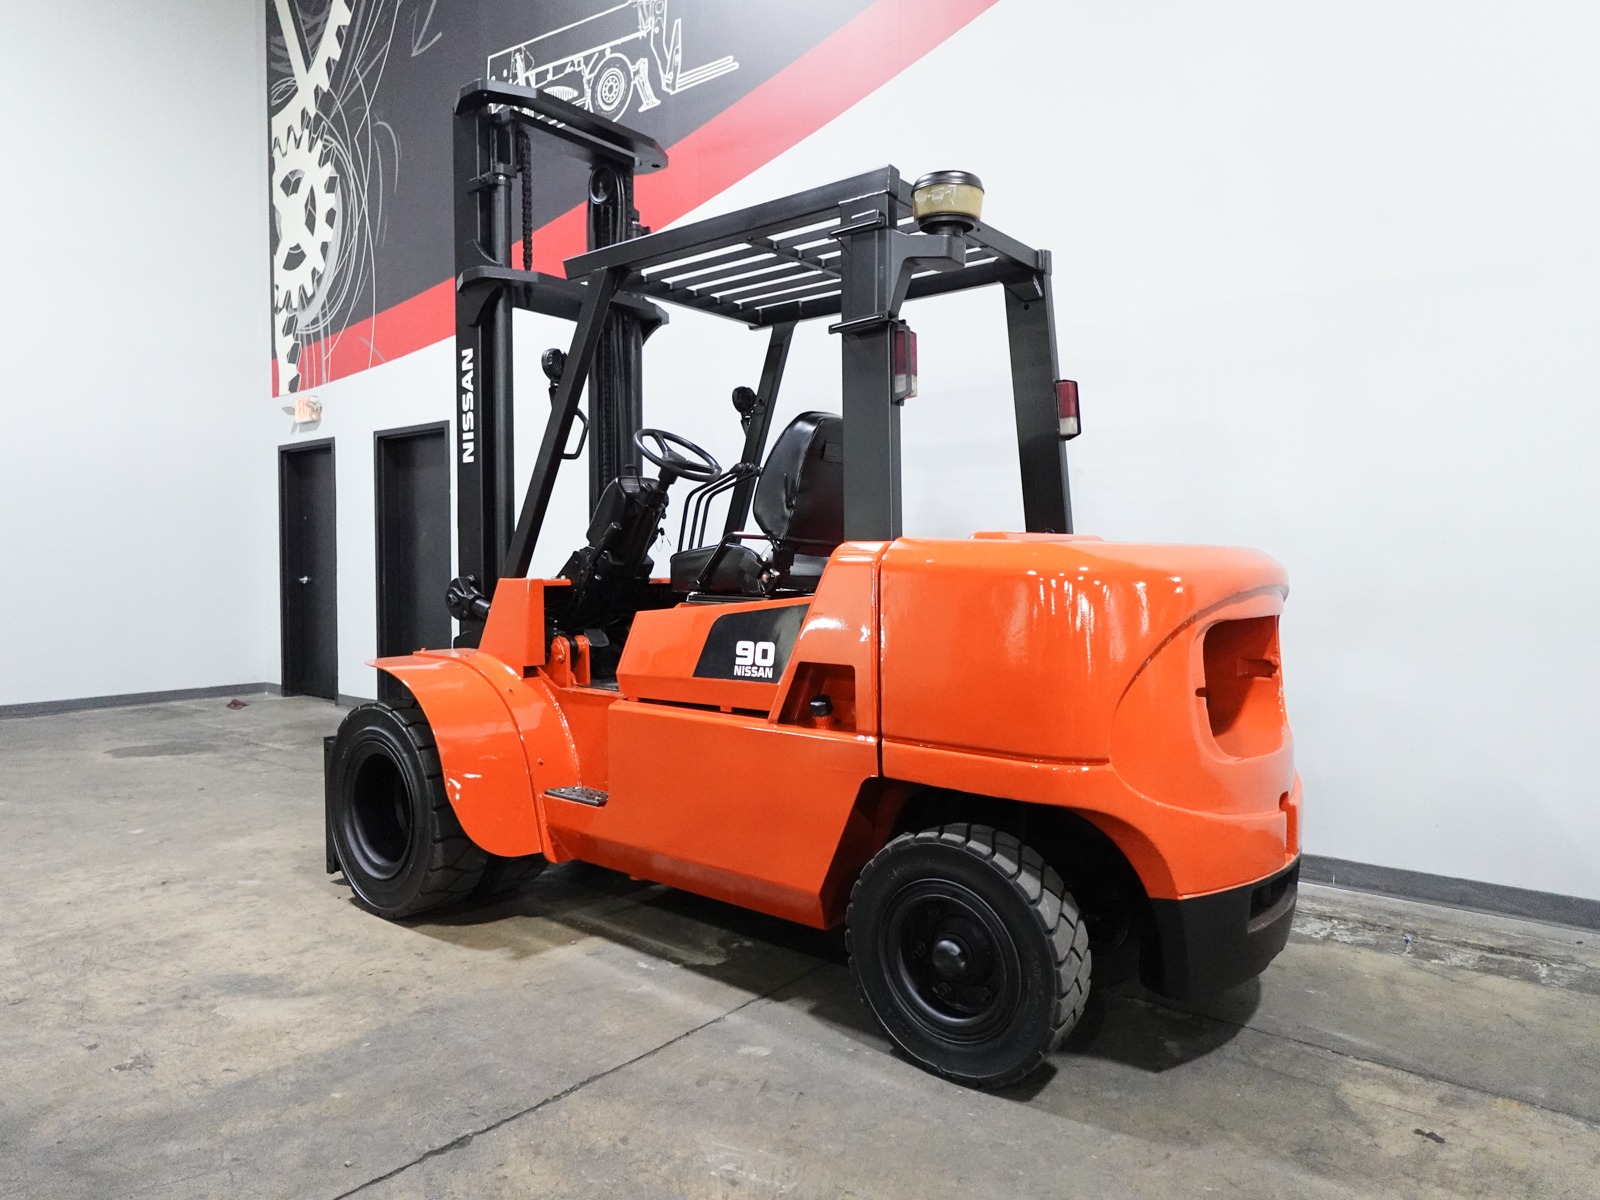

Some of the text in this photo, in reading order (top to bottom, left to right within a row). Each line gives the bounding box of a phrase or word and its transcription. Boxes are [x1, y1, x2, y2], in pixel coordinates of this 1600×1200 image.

[461, 348, 475, 464] NISSAN
[735, 640, 776, 667] 90
[733, 665, 774, 678] NISSAN
